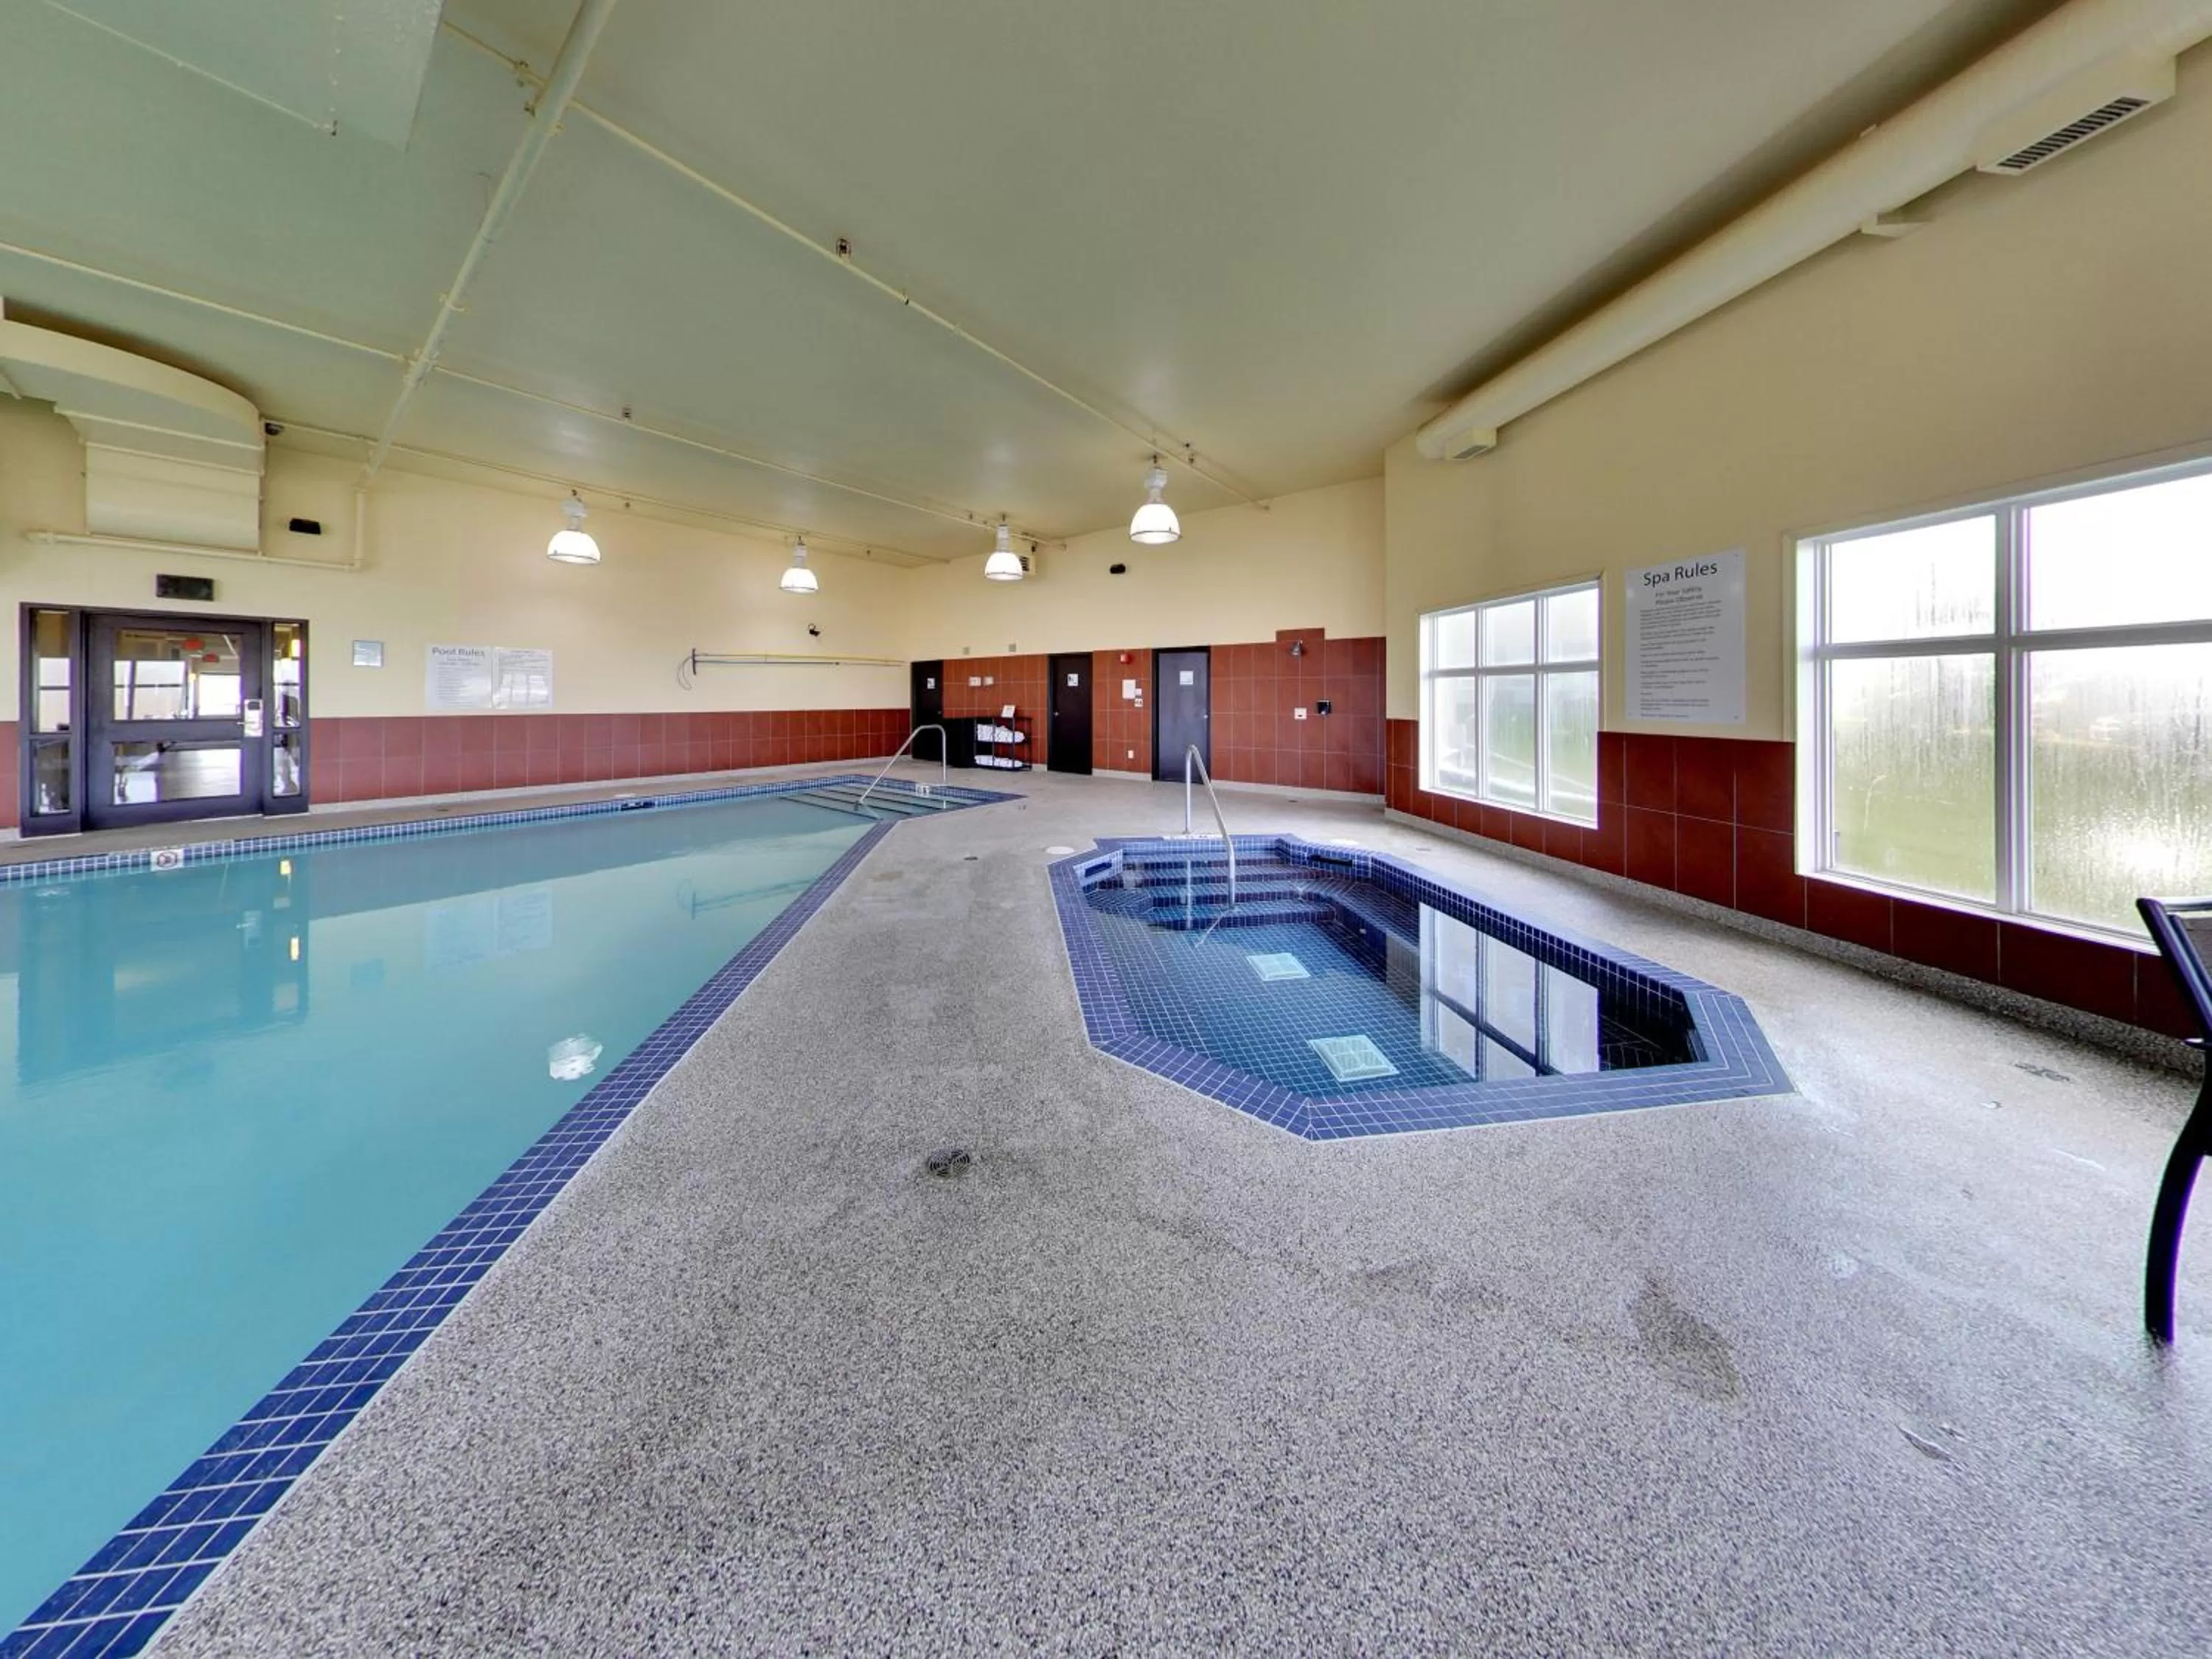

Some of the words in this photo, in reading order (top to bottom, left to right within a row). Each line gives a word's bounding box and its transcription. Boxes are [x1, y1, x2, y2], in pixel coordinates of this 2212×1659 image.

[1643, 571, 1670, 588] Spa
[1674, 562, 1718, 581] Rules
[431, 647, 456, 656] Pool
